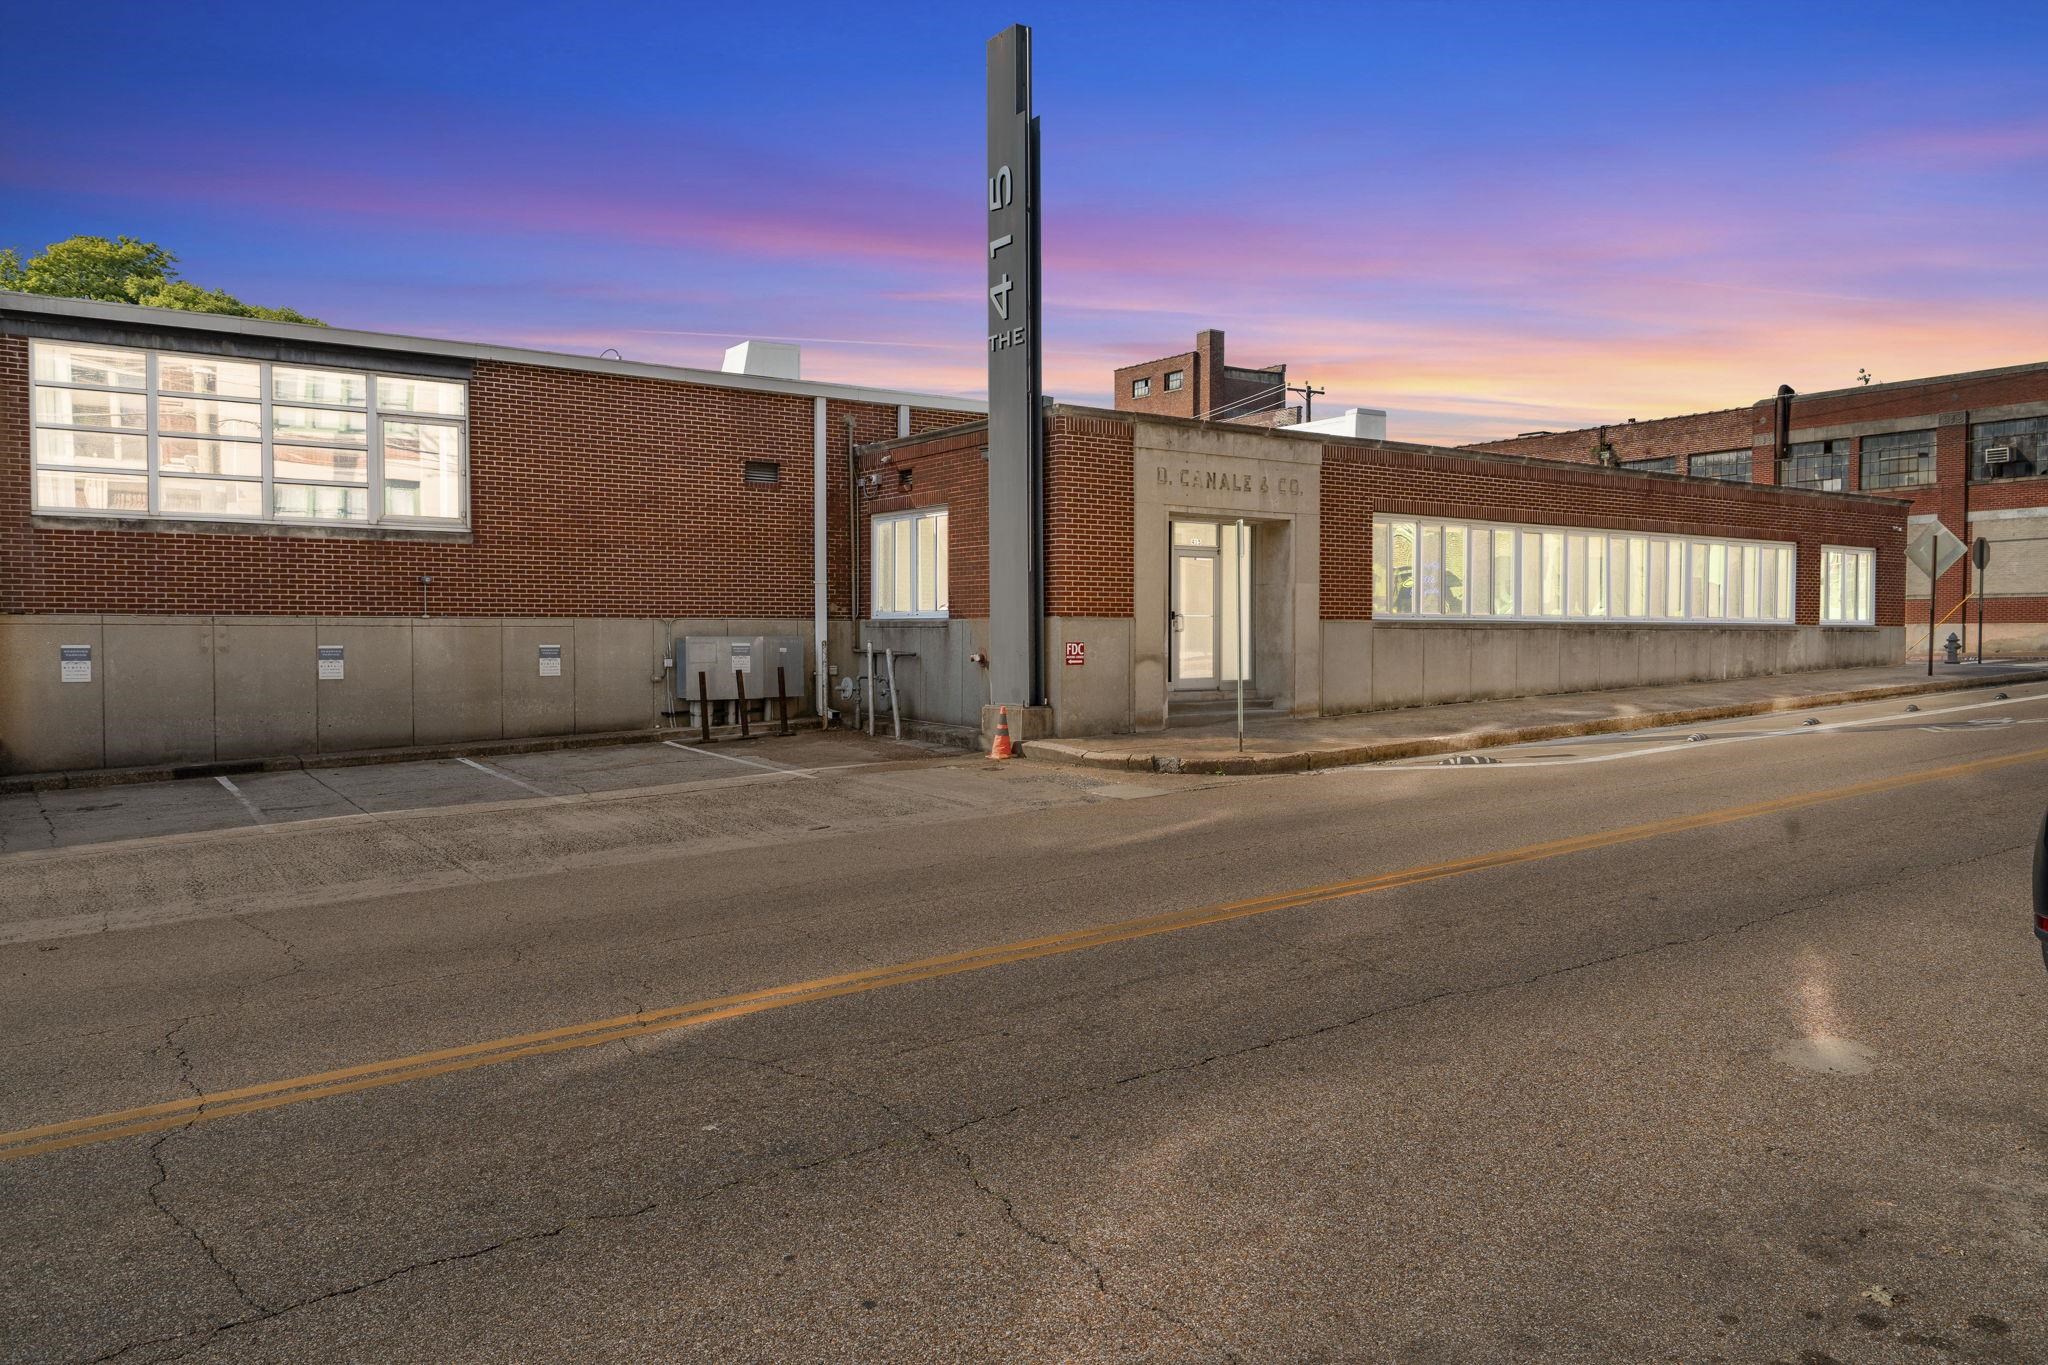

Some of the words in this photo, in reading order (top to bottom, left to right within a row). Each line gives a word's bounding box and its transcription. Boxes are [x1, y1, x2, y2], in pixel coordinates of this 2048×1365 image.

[989, 165, 1013, 320] 415
[988, 326, 1025, 351] THE
[1156, 466, 1173, 486] D.
[1180, 469, 1252, 493] CANALE
[1259, 476, 1269, 494] &
[1277, 477, 1303, 497] CO.
[1066, 643, 1084, 655] FDC
